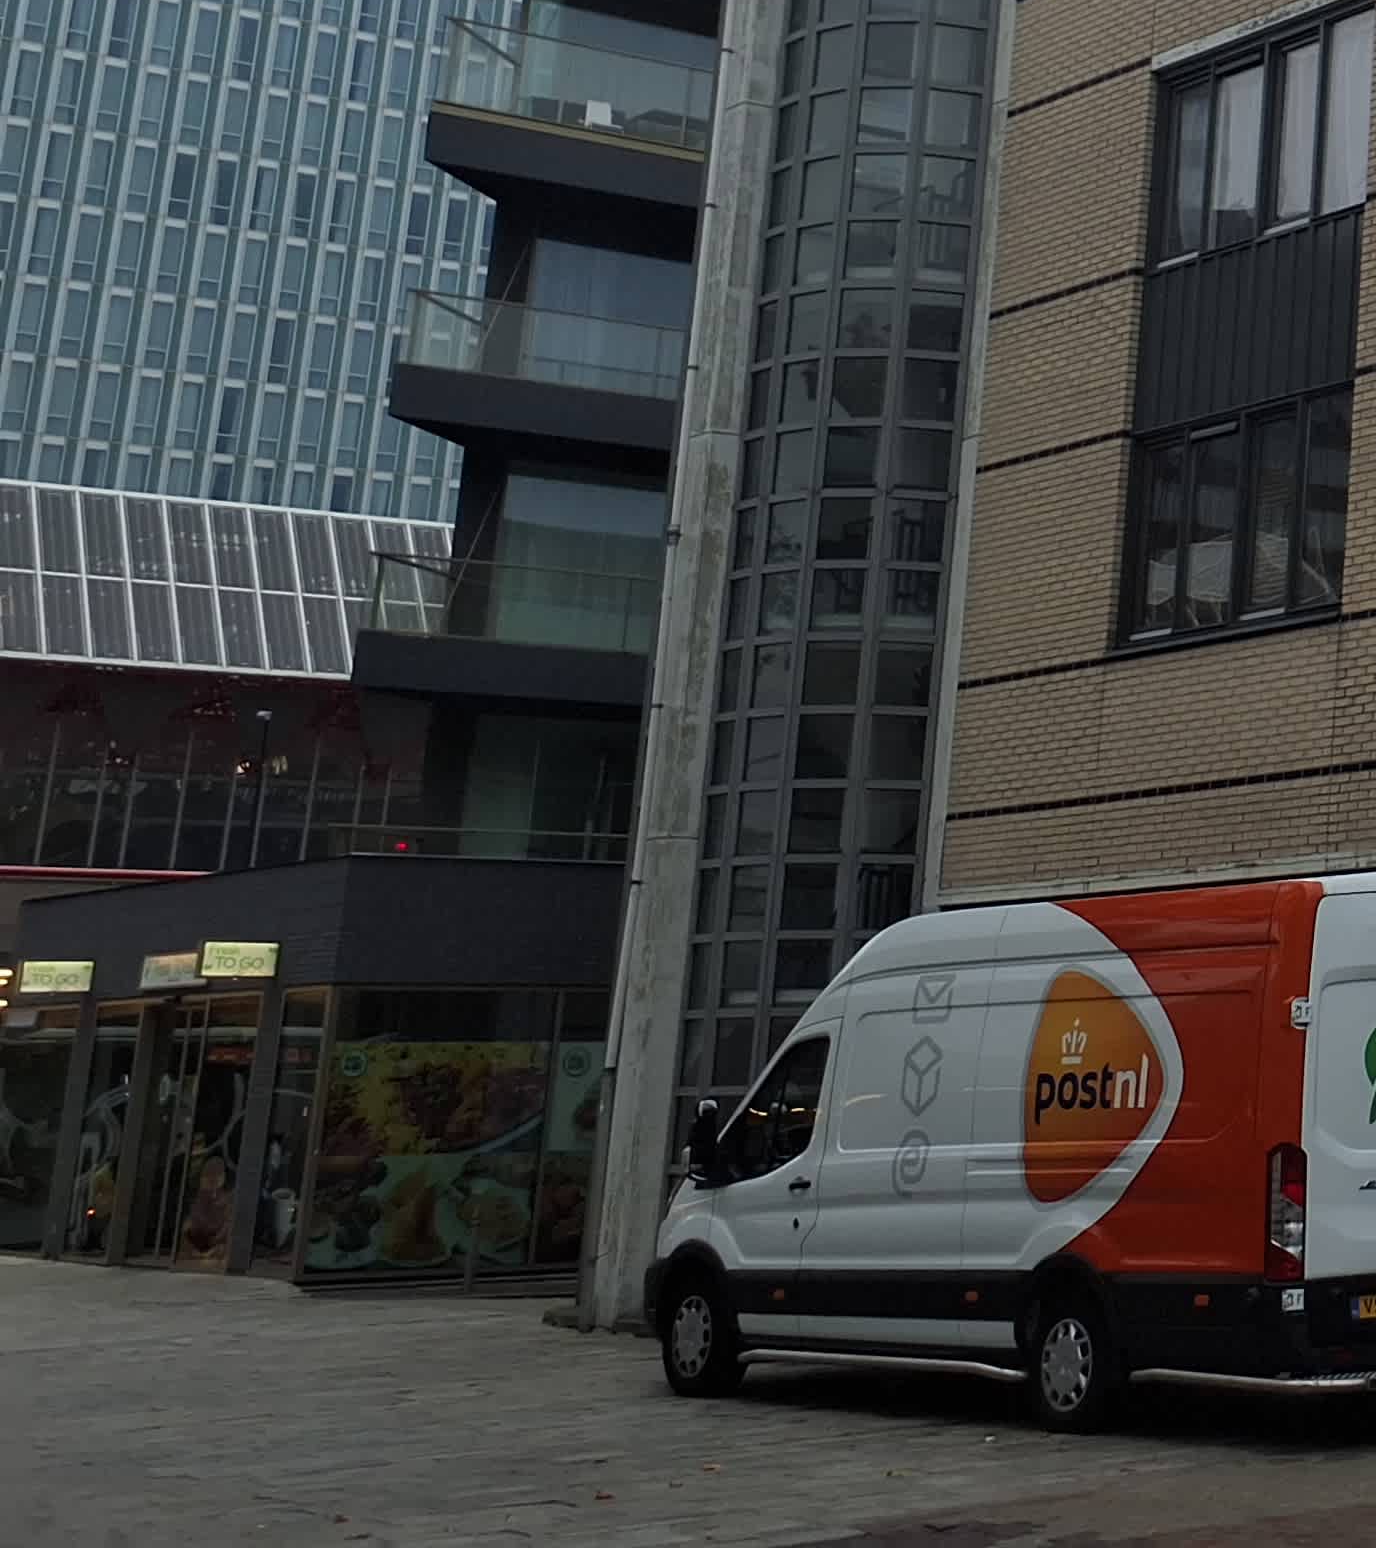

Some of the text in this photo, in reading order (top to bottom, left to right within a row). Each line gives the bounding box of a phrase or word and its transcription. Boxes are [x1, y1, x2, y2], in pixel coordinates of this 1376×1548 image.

[214, 956, 237, 970] TO
[239, 956, 265, 970] GO
[1034, 1052, 1149, 1124] postnl
